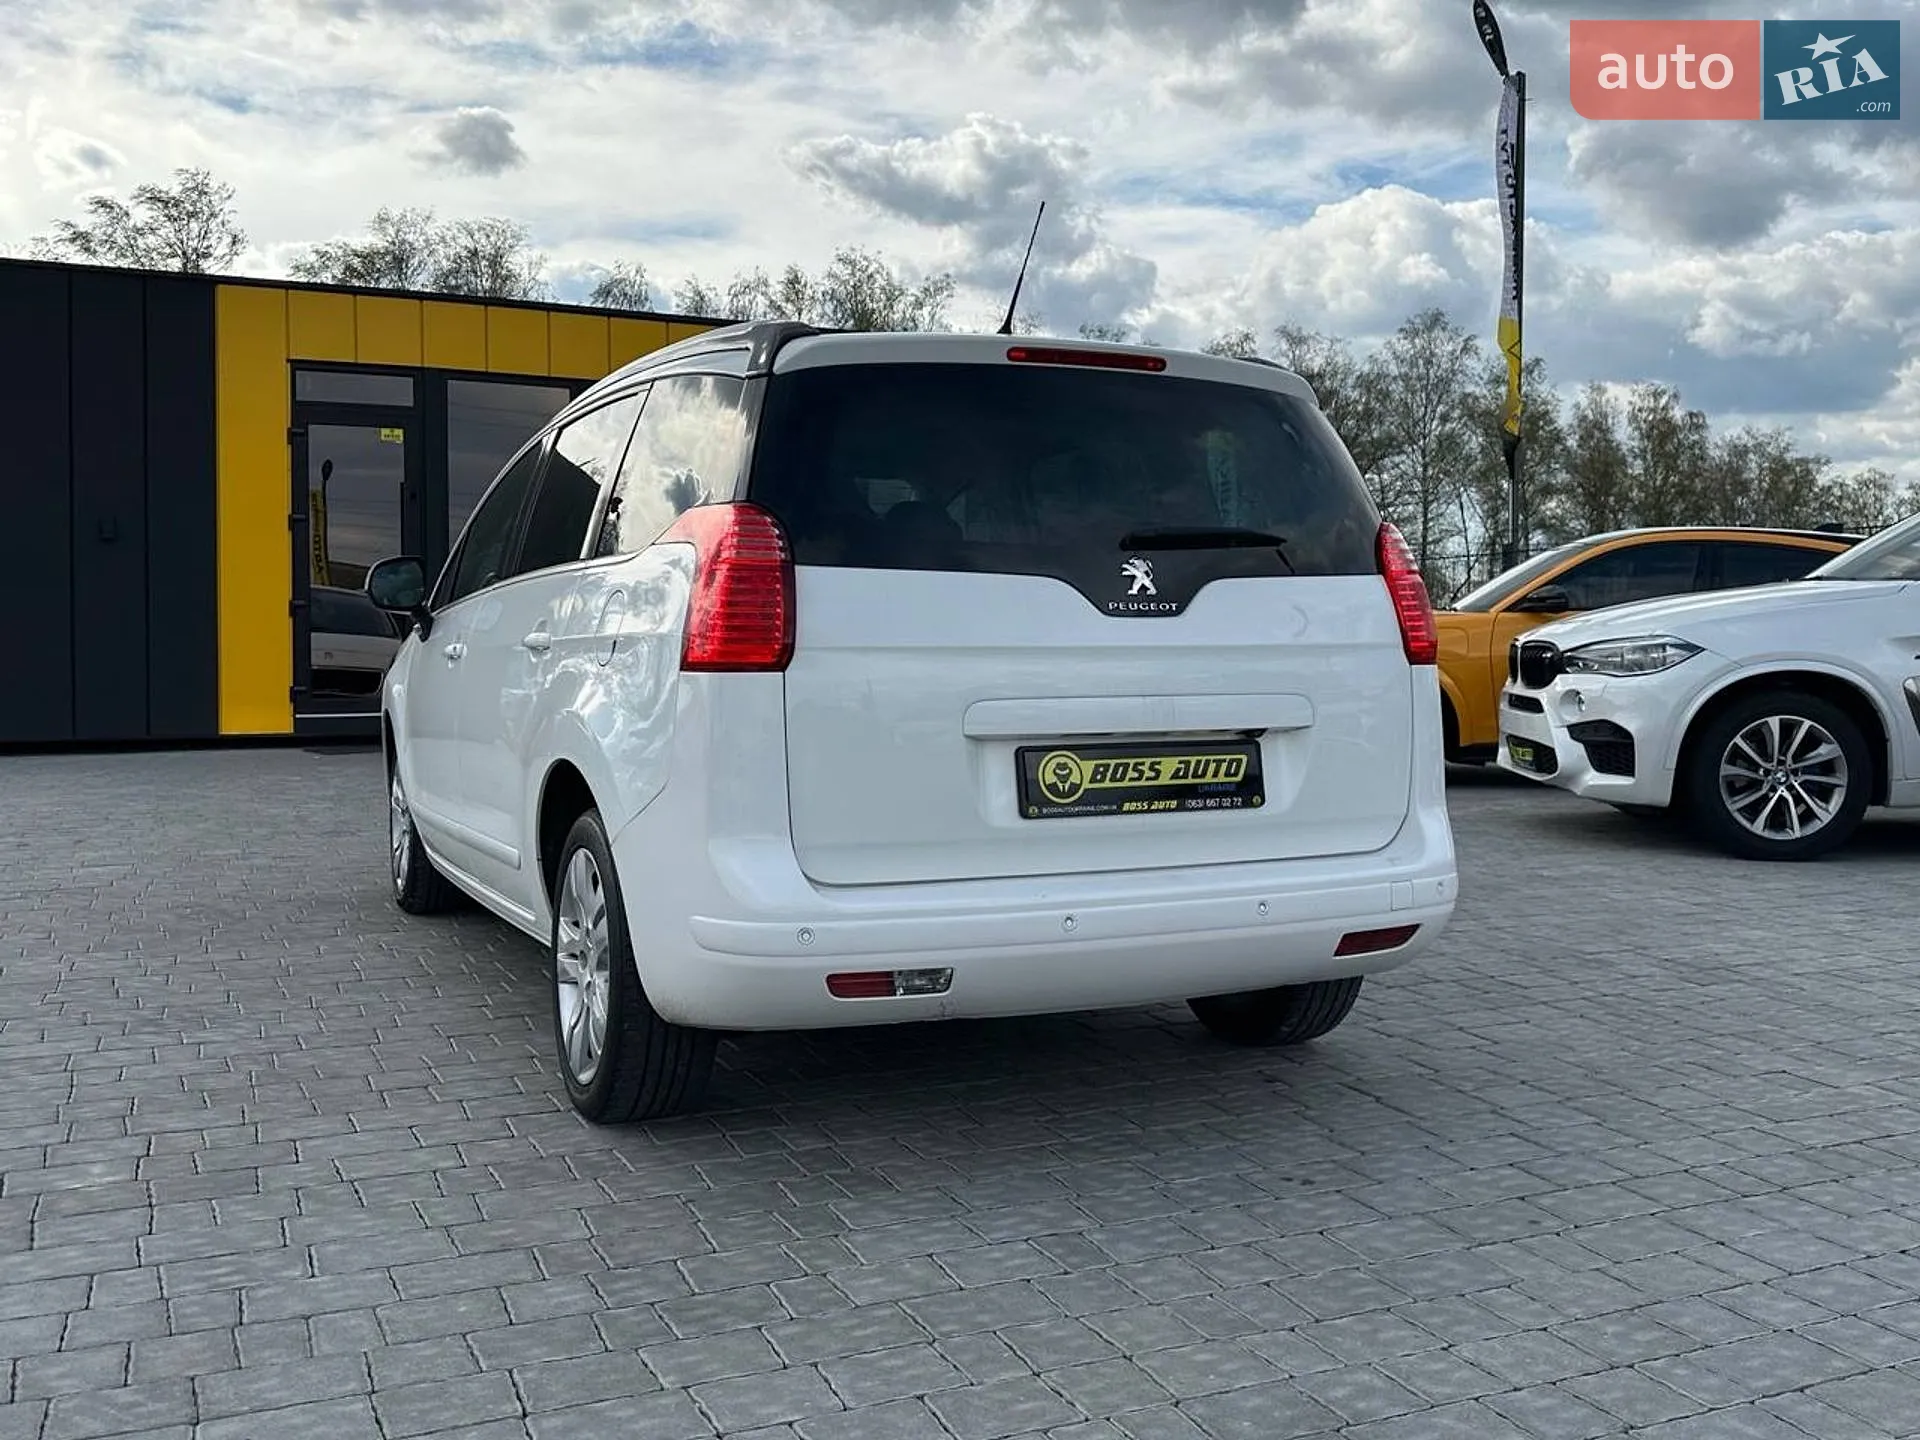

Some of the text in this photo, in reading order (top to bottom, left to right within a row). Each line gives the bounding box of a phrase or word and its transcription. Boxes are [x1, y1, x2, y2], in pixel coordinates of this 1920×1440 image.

[1108, 601, 1179, 611] PEUGEOT
[1089, 757, 1244, 784] BOSS AUTO
[1122, 800, 1178, 812] BOSS AUTO
